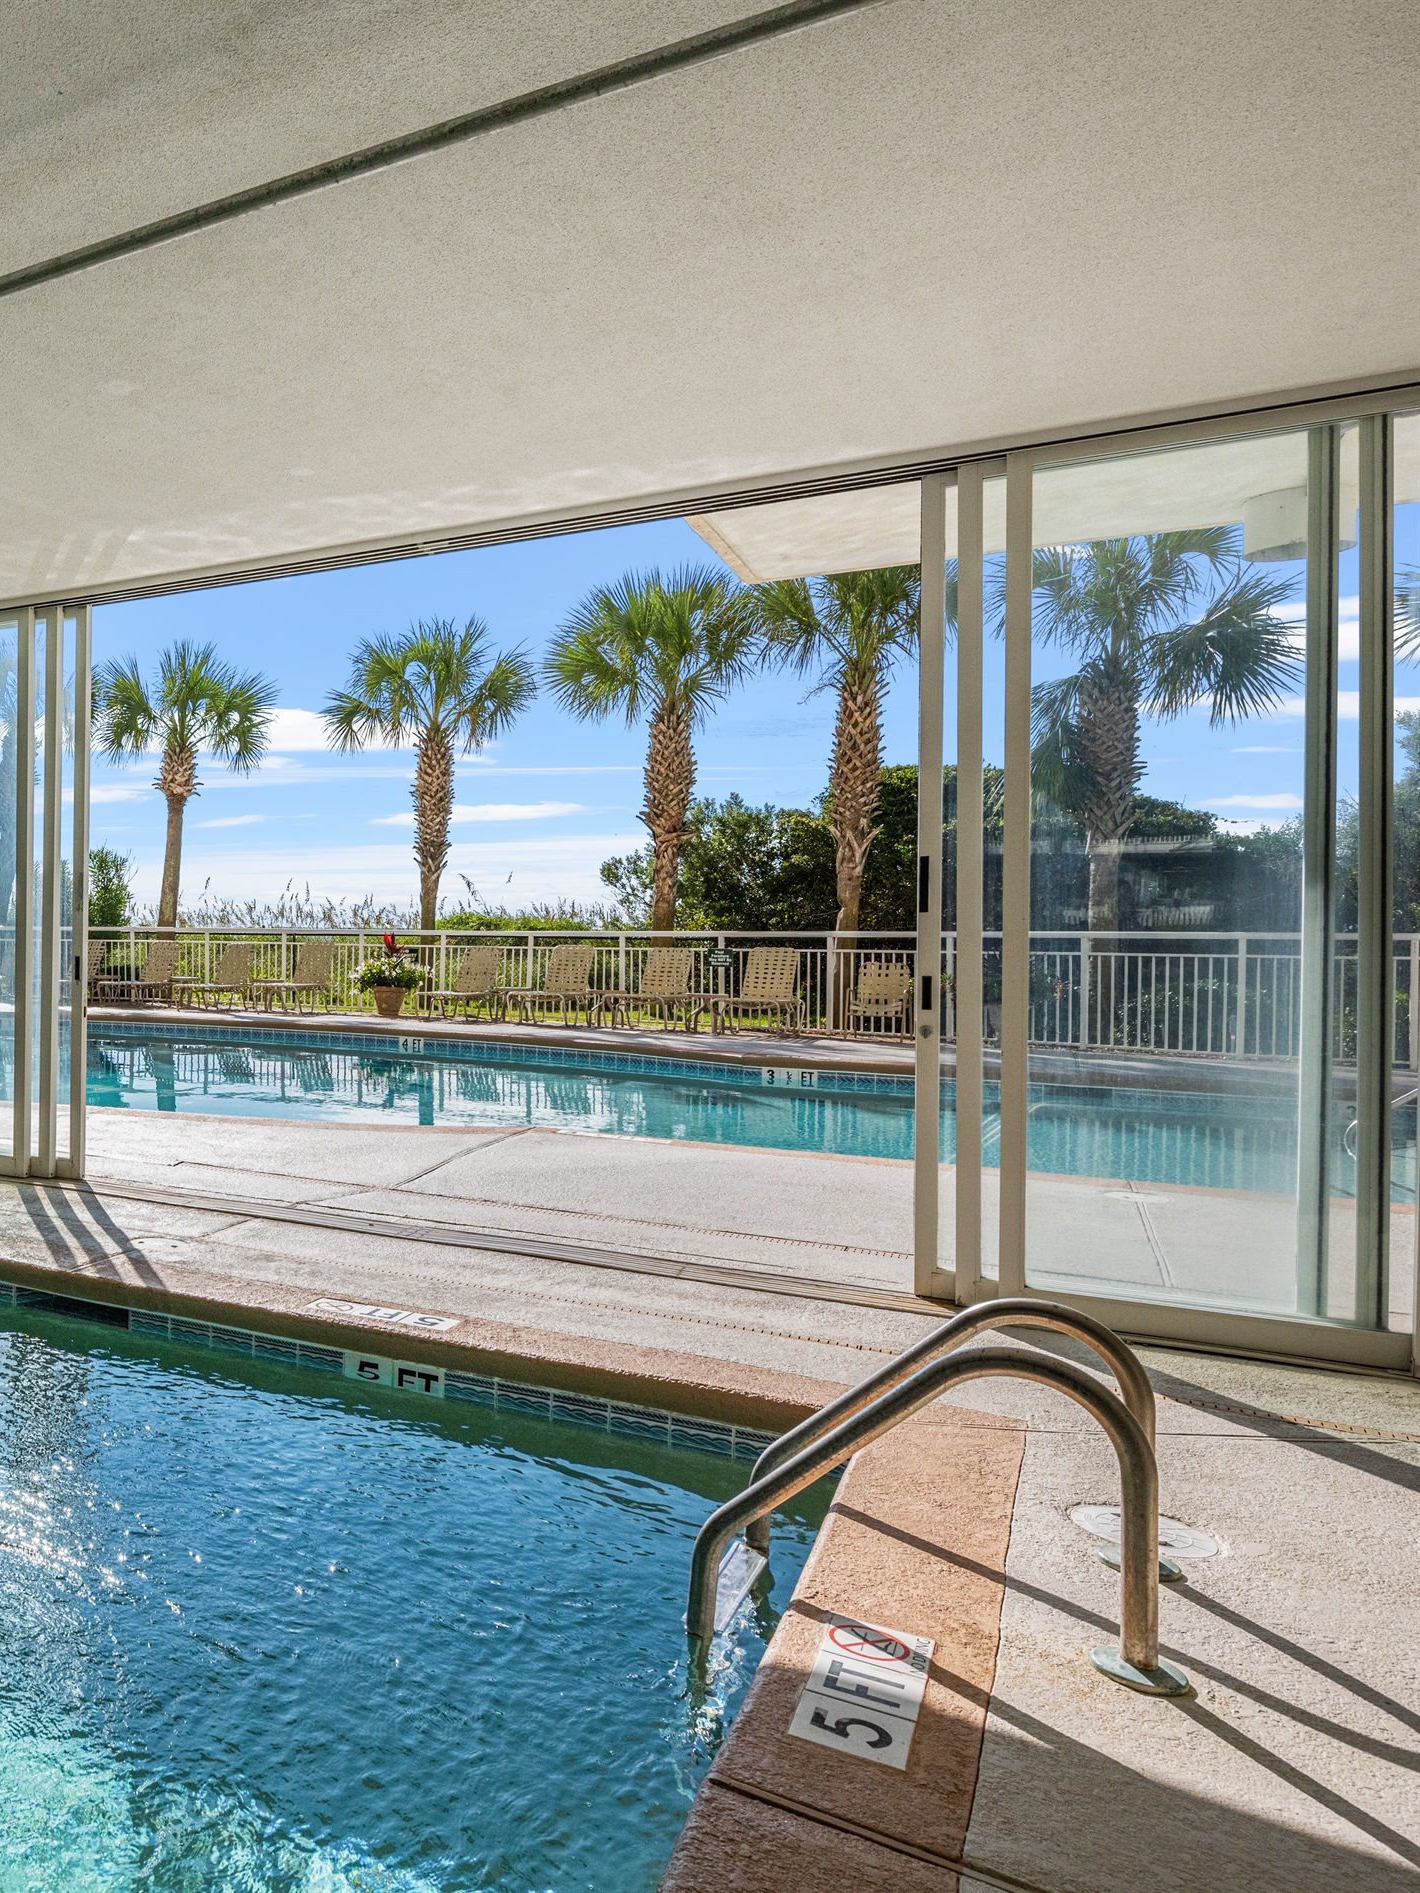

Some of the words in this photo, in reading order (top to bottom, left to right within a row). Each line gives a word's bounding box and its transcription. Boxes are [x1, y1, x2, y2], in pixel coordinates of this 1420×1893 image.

[360, 1308, 402, 1320] FT
[413, 1316, 445, 1327] 5
[357, 1360, 380, 1380] 5
[398, 1367, 439, 1393] FT
[823, 1660, 905, 1709] FT
[810, 1706, 893, 1749] 5
